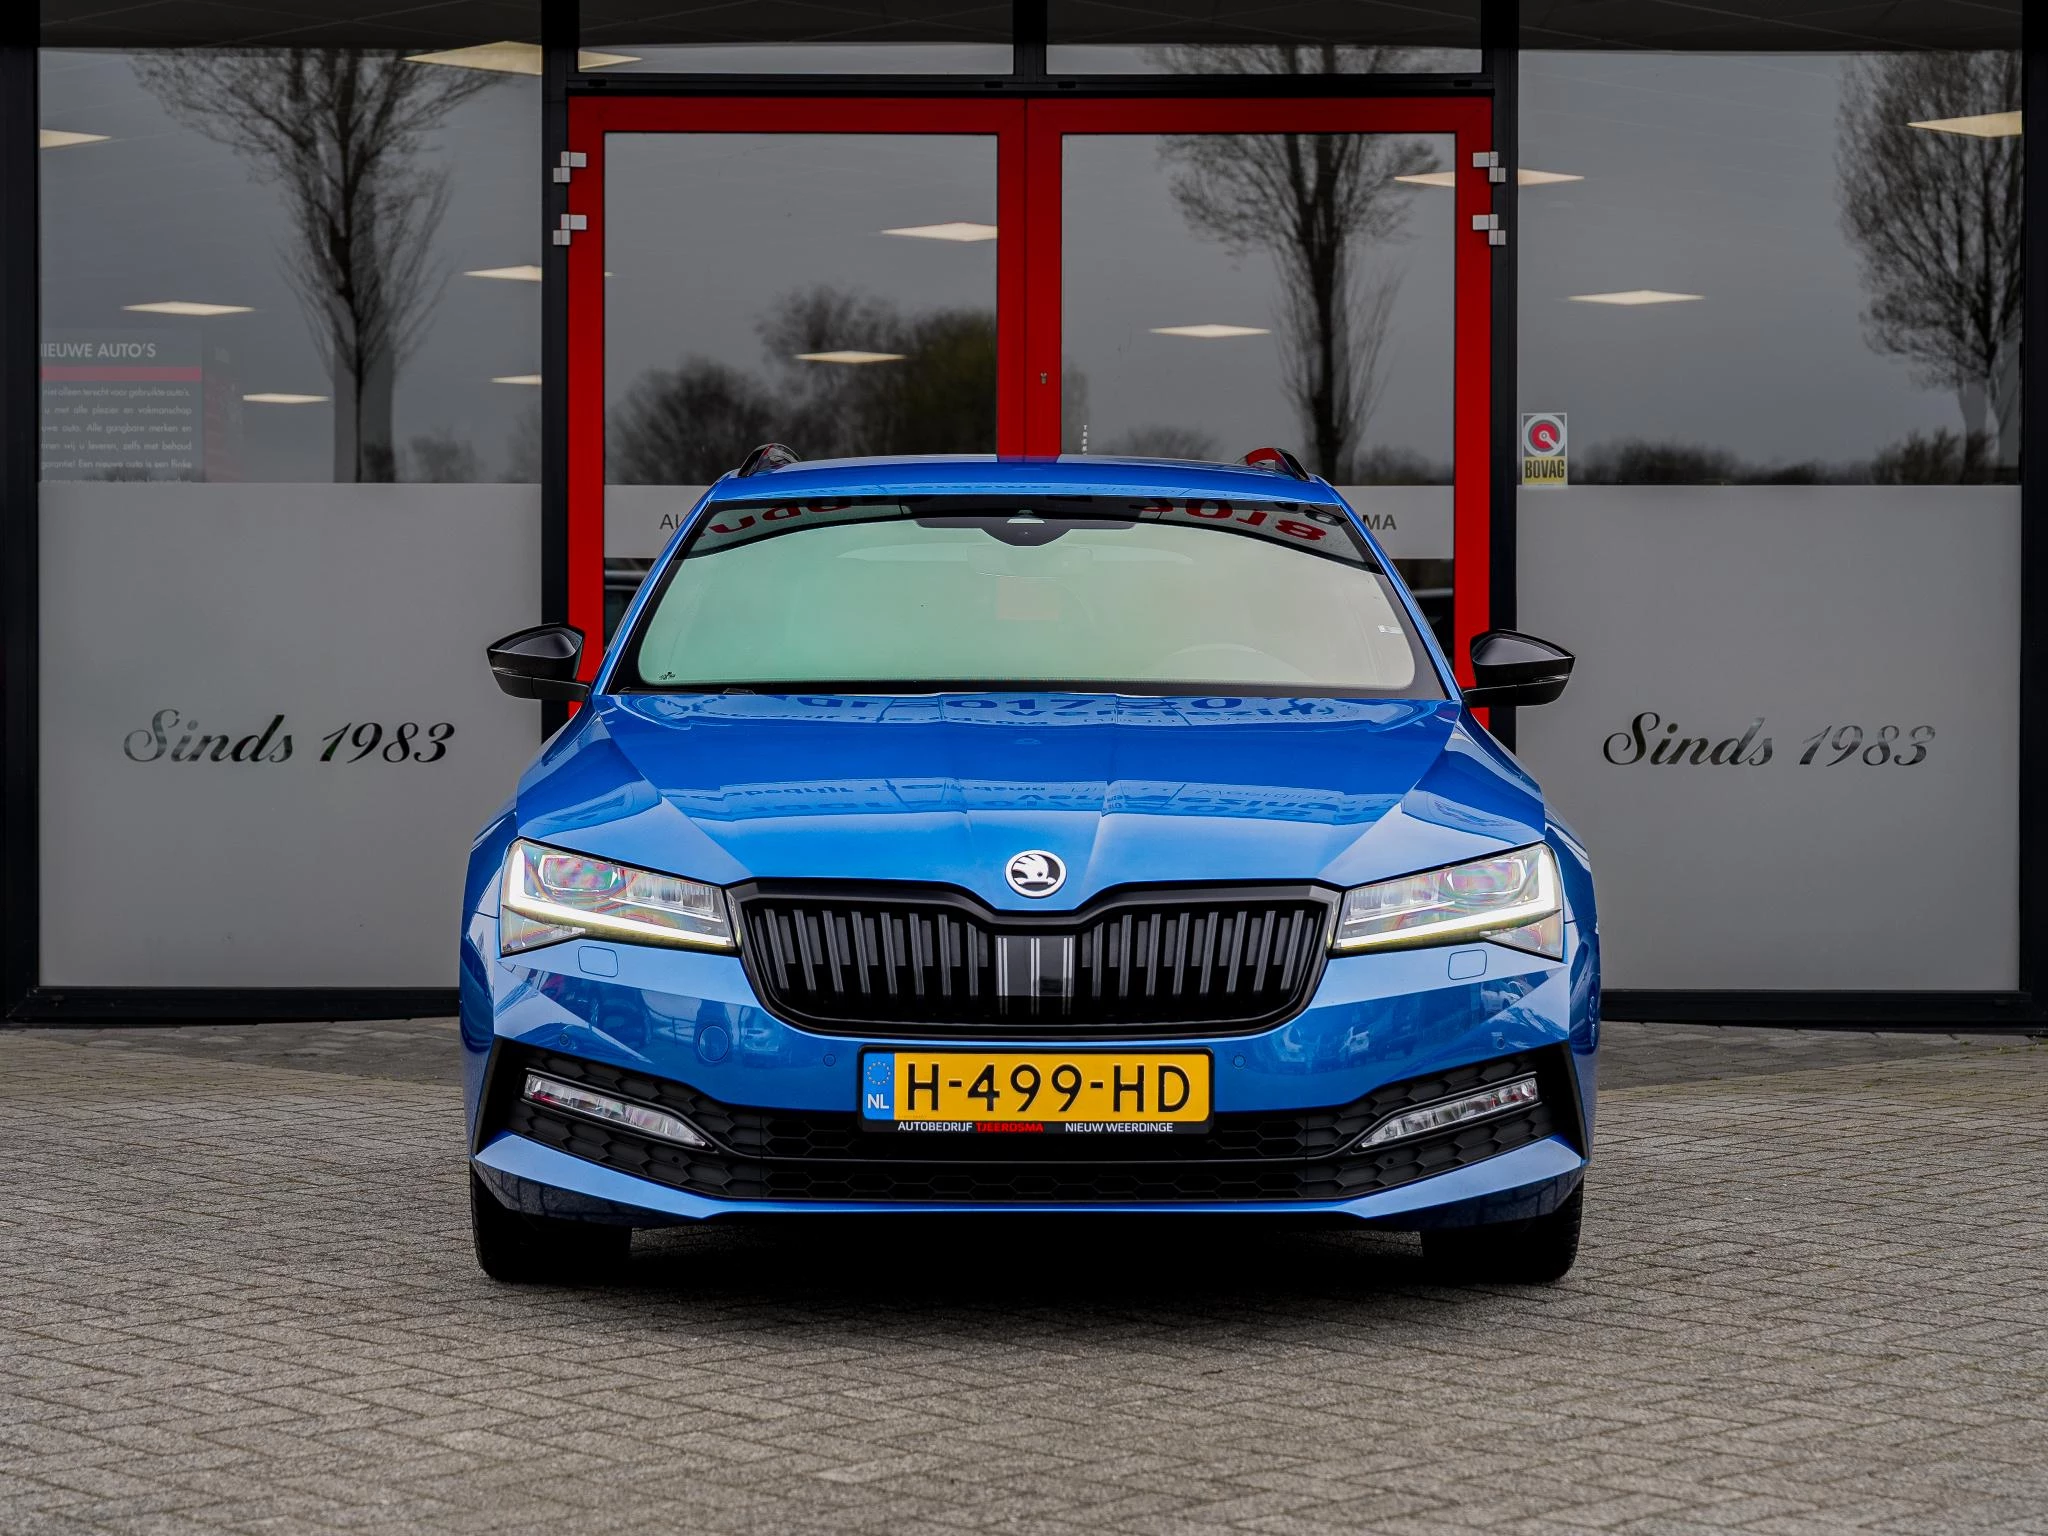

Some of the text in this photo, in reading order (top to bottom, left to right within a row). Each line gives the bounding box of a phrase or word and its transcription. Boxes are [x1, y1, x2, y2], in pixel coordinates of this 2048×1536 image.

[97, 343, 156, 358] AUTO'S
[86, 422, 102, 432] Alle
[148, 423, 178, 432] merken
[1525, 459, 1565, 479] BOVAG
[123, 708, 456, 764] Sinds 1983
[1602, 711, 1937, 767] Sinds 1983
[867, 1063, 1190, 1113] NL H-499-HD
[898, 1121, 973, 1132] AUTOBEDRIJF
[1065, 1122, 1103, 1133] NIEUW
[1105, 1122, 1174, 1133] WEERDINGE
